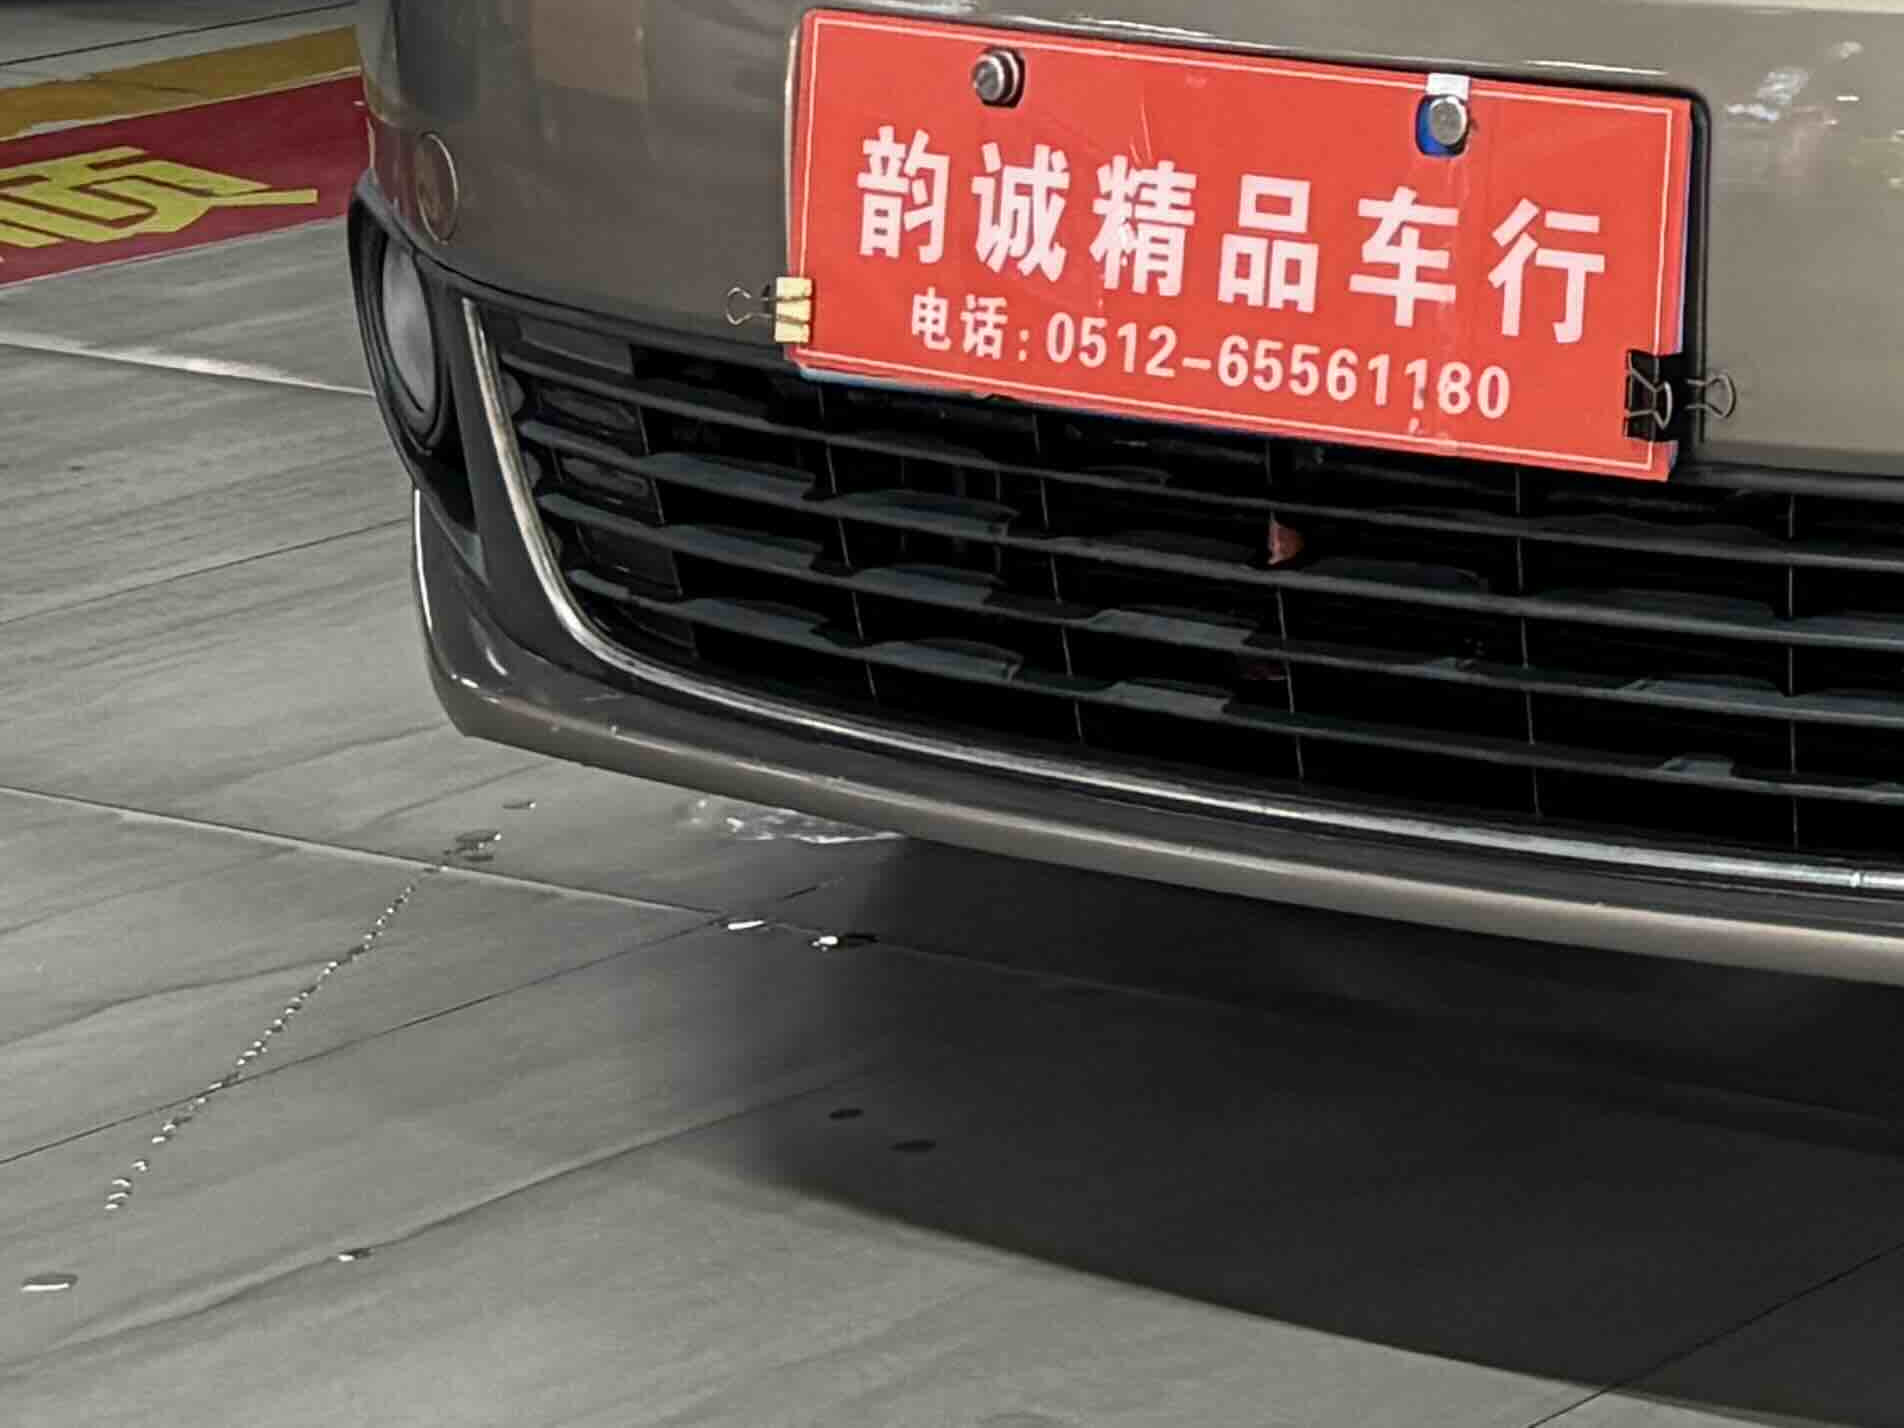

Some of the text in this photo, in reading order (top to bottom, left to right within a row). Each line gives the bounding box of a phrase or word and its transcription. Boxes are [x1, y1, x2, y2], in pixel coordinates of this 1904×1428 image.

[856, 123, 1606, 344] 韵诚精品车行
